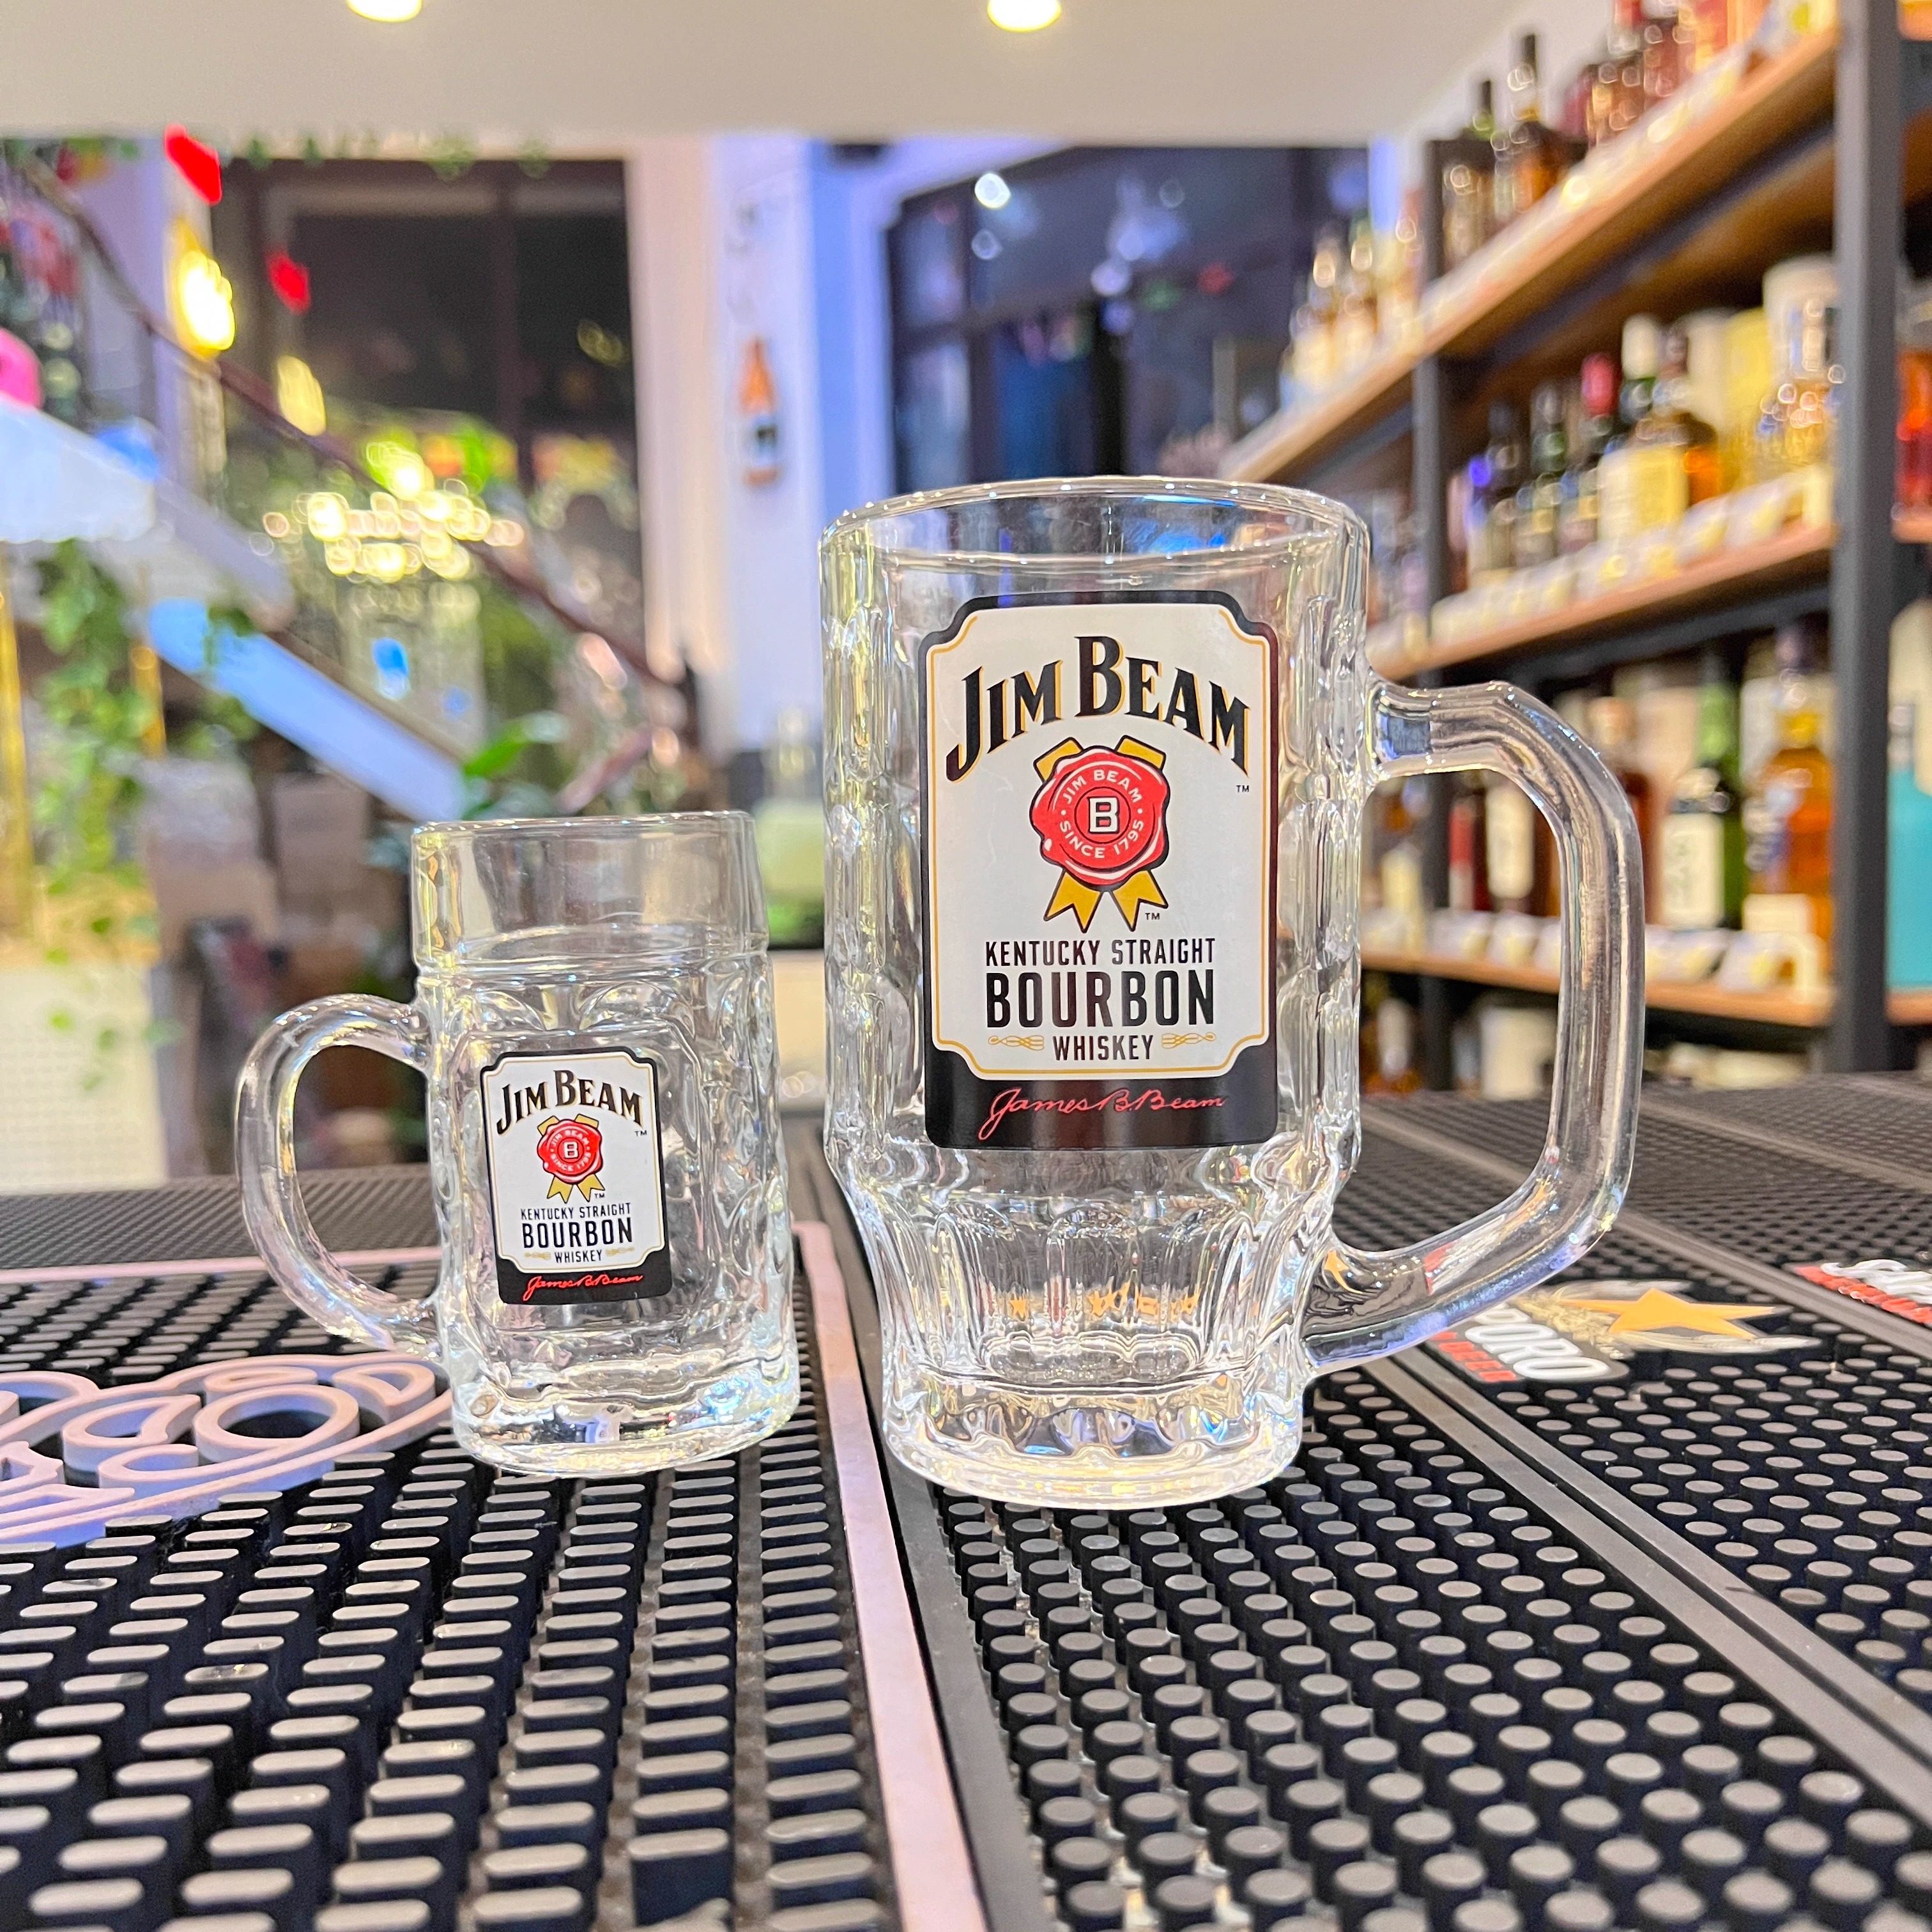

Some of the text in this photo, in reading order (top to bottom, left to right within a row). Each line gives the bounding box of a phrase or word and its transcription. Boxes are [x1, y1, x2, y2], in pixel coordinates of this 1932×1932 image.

[946, 636, 1251, 782] JIM BEAM
[1062, 769, 1142, 804] JIM BEAM
[1087, 796, 1120, 834] B
[1059, 818, 1144, 859] SINCE 1795
[985, 938, 1216, 967] KENTUCKY STRAIGHT
[986, 969, 1215, 1028] BOURBON
[1052, 1034, 1154, 1061] WHISKEY
[496, 1070, 644, 1135] JIM BEAM
[977, 1088, 1094, 1140] James
[1133, 1088, 1227, 1112] Beam
[564, 1141, 579, 1159] B
[521, 1202, 631, 1220] KENTUCKY STRAIGHT
[522, 1217, 633, 1248] BOURBON
[554, 1250, 602, 1263] WHISKEY
[1465, 1301, 1611, 1380] PORO
